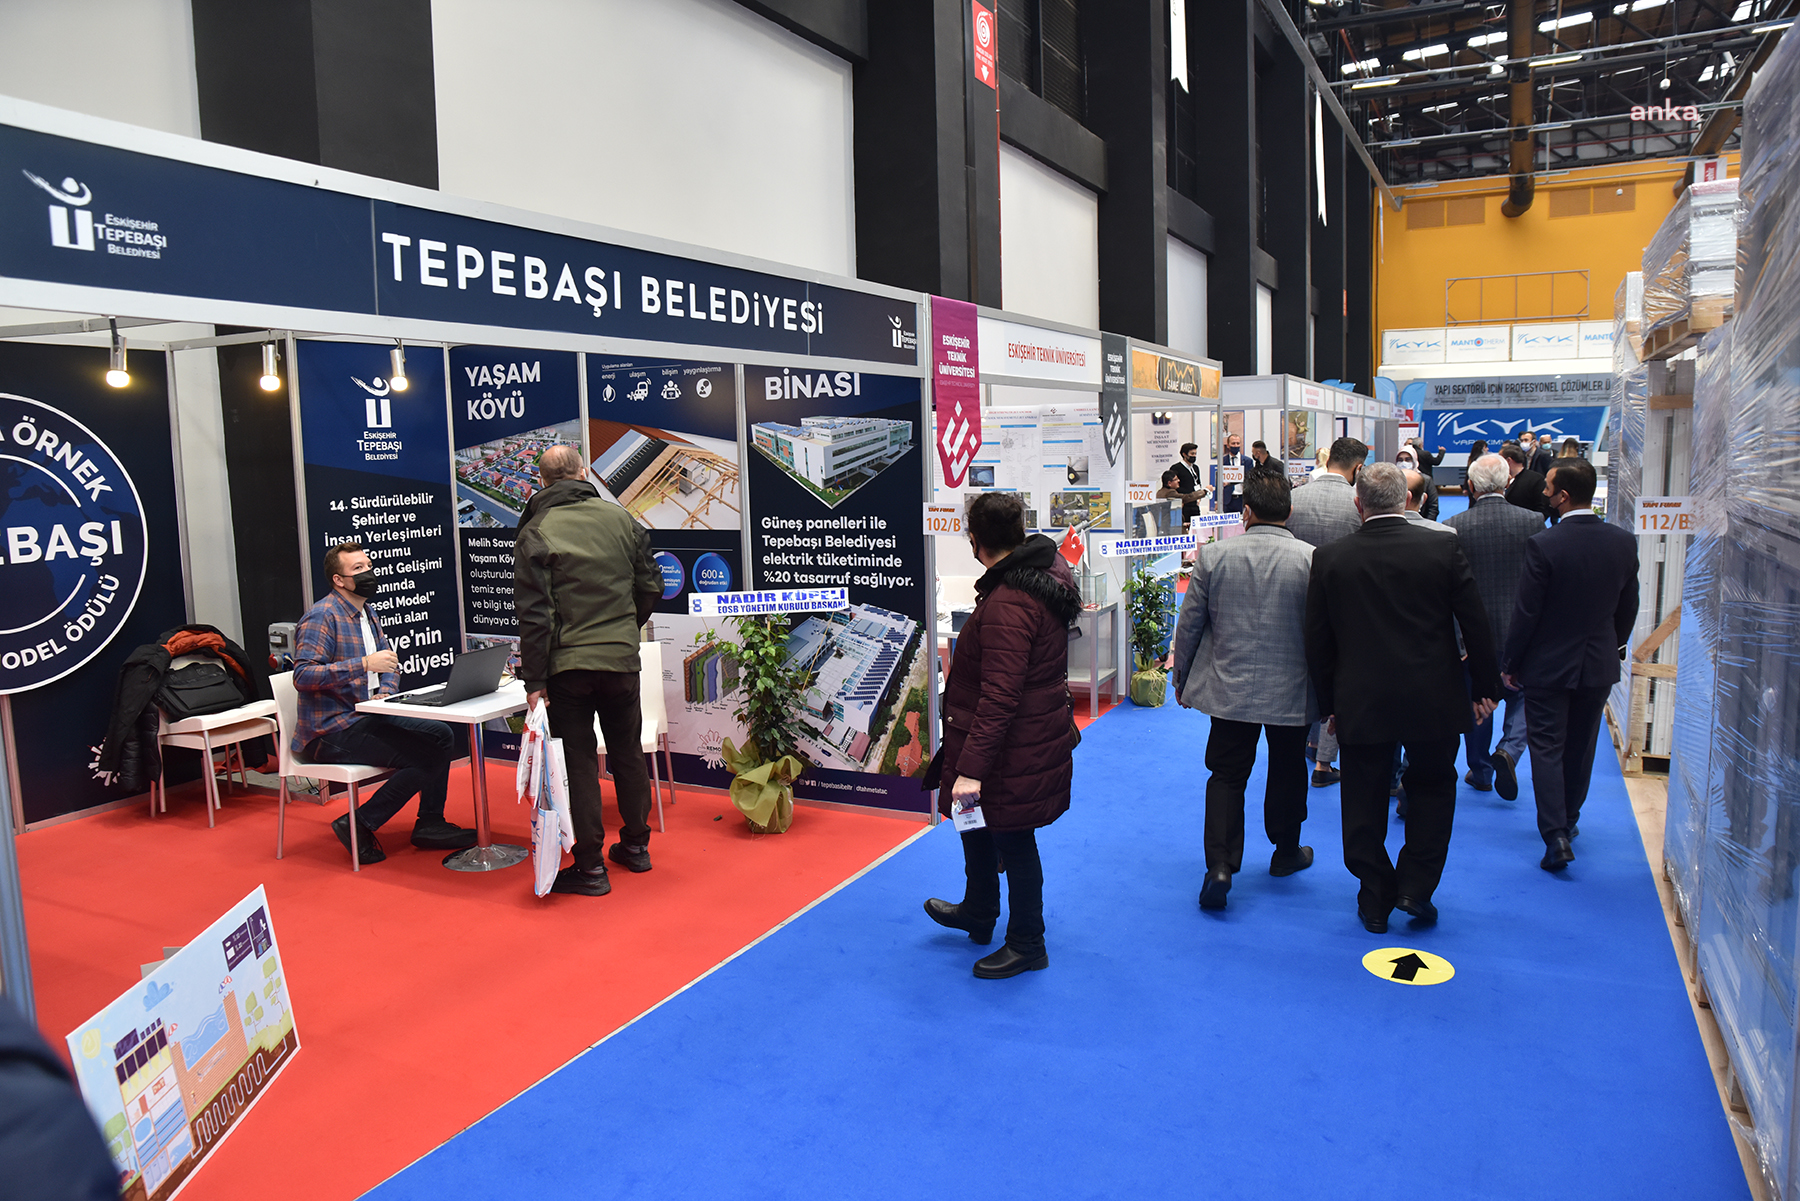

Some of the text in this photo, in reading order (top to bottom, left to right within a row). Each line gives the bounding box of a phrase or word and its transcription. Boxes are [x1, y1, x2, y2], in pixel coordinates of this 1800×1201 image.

[381, 232, 622, 318] TEPEBAŞI
[1008, 341, 1086, 367] ESKİŞEHİR TEKNİK ÜNİVERSİTESİ
[464, 361, 541, 390] YAŞAM
[765, 368, 861, 400] BİNASI
[1434, 384, 1451, 395] YAPI
[1452, 382, 1486, 395] SEKTÖRÜ
[1505, 382, 1558, 393] PROFESYONEL
[467, 390, 525, 420] KÖYÜ
[1453, 418, 1564, 436] KYK
[12, 415, 113, 502] ÖRNEK
[329, 493, 434, 512] 14. Sürdürülebilir
[1128, 491, 1153, 501] 102/C
[352, 511, 417, 529] Şehirler ve
[761, 516, 887, 532] Güneş panelleri ile
[926, 517, 961, 533] 102/B
[1640, 513, 1689, 531] 112/B
[365, 525, 442, 543] Yerleşimleri
[468, 537, 491, 548] Melih
[761, 534, 896, 551] Tepebaşı Belediyesi
[1116, 535, 1195, 548] NADİR KÜPELİ
[0, 519, 124, 567] BAŞI
[396, 558, 443, 573] Gelişimi
[469, 553, 515, 565] Yaşam Köy
[762, 552, 903, 568] elektrik tüketiminde
[701, 569, 718, 579] 600
[763, 570, 914, 589] %20 tasarruf sağlıyor.
[375, 578, 415, 594] anında
[471, 584, 515, 595] temiz ener
[370, 598, 395, 612] esel
[472, 599, 516, 612] ve bilgi tek
[716, 591, 776, 604] NADİR
[63, 574, 120, 642] ÖDÜLÜ
[718, 605, 739, 614] EOSB
[778, 602, 810, 611] KURULU
[380, 610, 429, 628] ünü alan
[473, 614, 510, 626] dünyaya
[0, 639, 68, 670] ODEL
[398, 647, 455, 676] ediyesi
